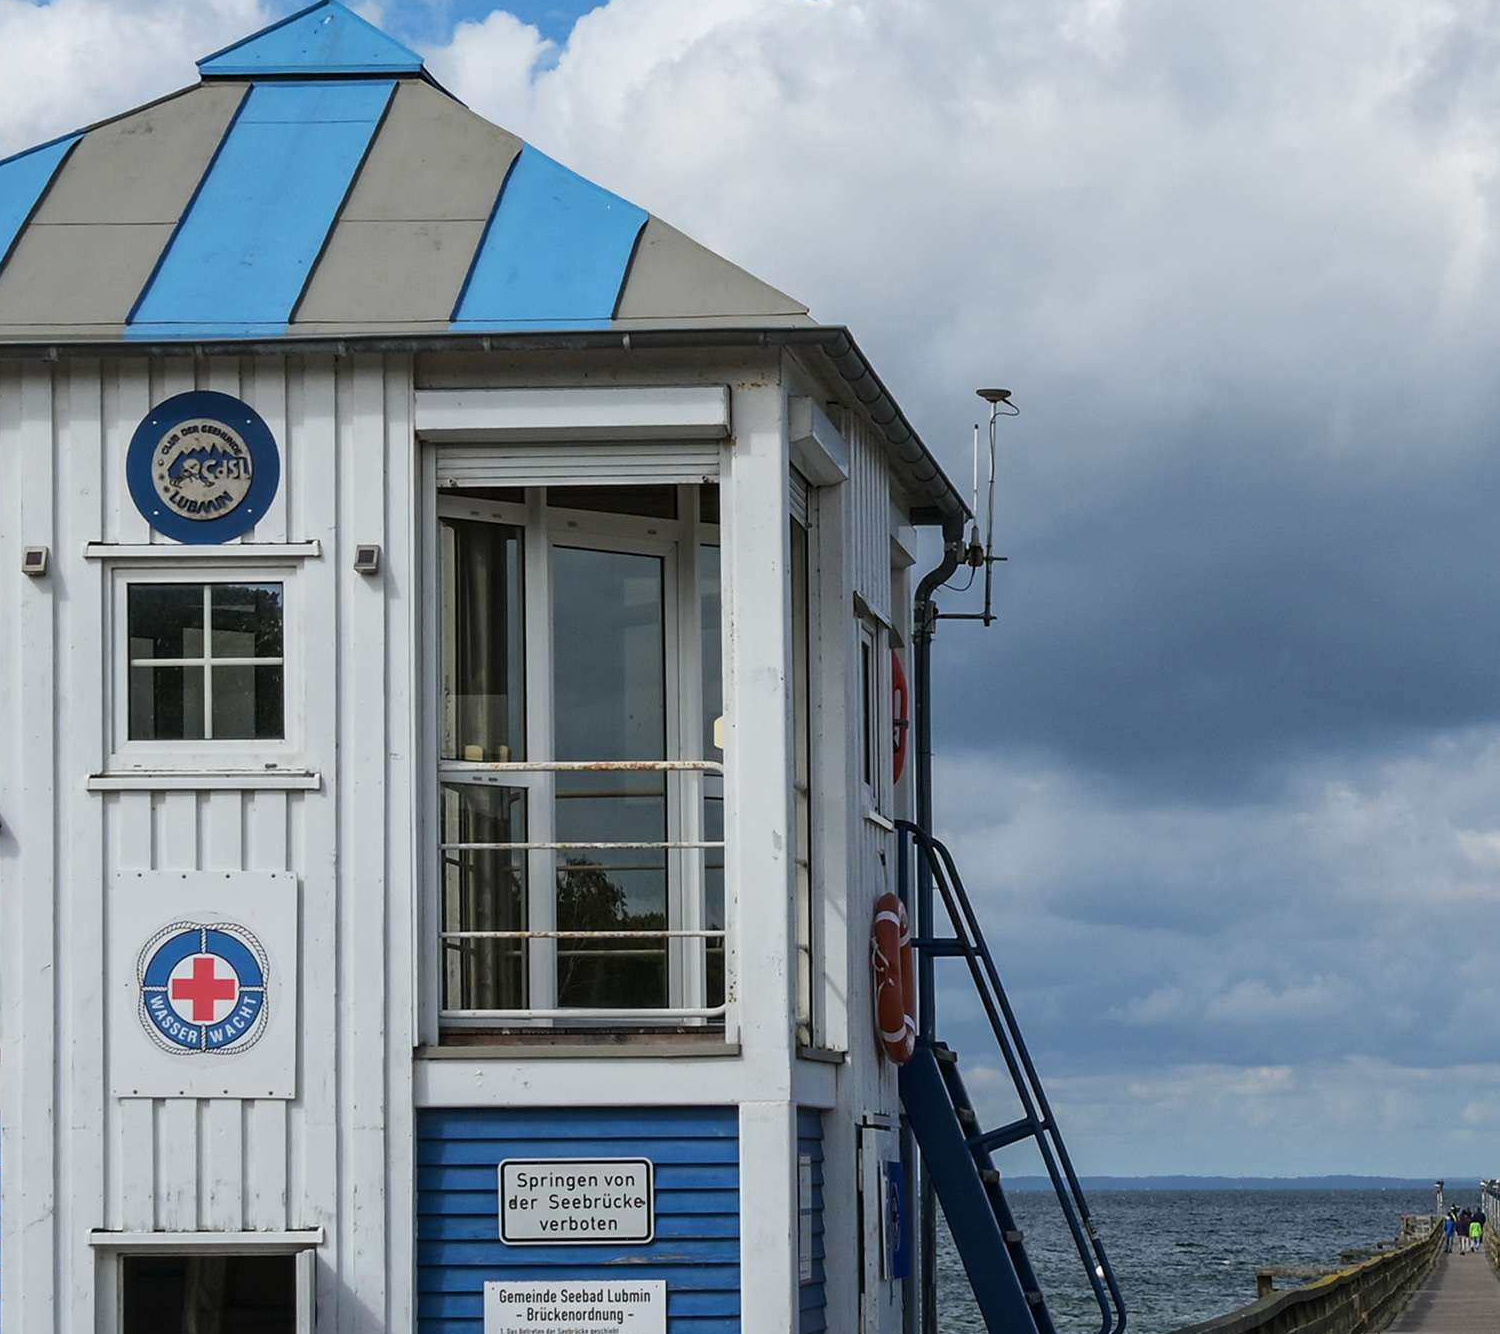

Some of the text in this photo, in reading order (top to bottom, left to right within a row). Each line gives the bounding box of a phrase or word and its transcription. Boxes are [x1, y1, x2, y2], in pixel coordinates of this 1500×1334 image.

[169, 490, 234, 514] LUBMIN
[150, 995, 257, 1044] WASSER WACHT
[517, 1172, 635, 1191] Springen von
[508, 1193, 644, 1210] der Seebrücke
[539, 1216, 618, 1231] verboten
[500, 1288, 651, 1303] Gemeinde Seebad Lubmin
[527, 1307, 624, 1324] Brückenordnung
